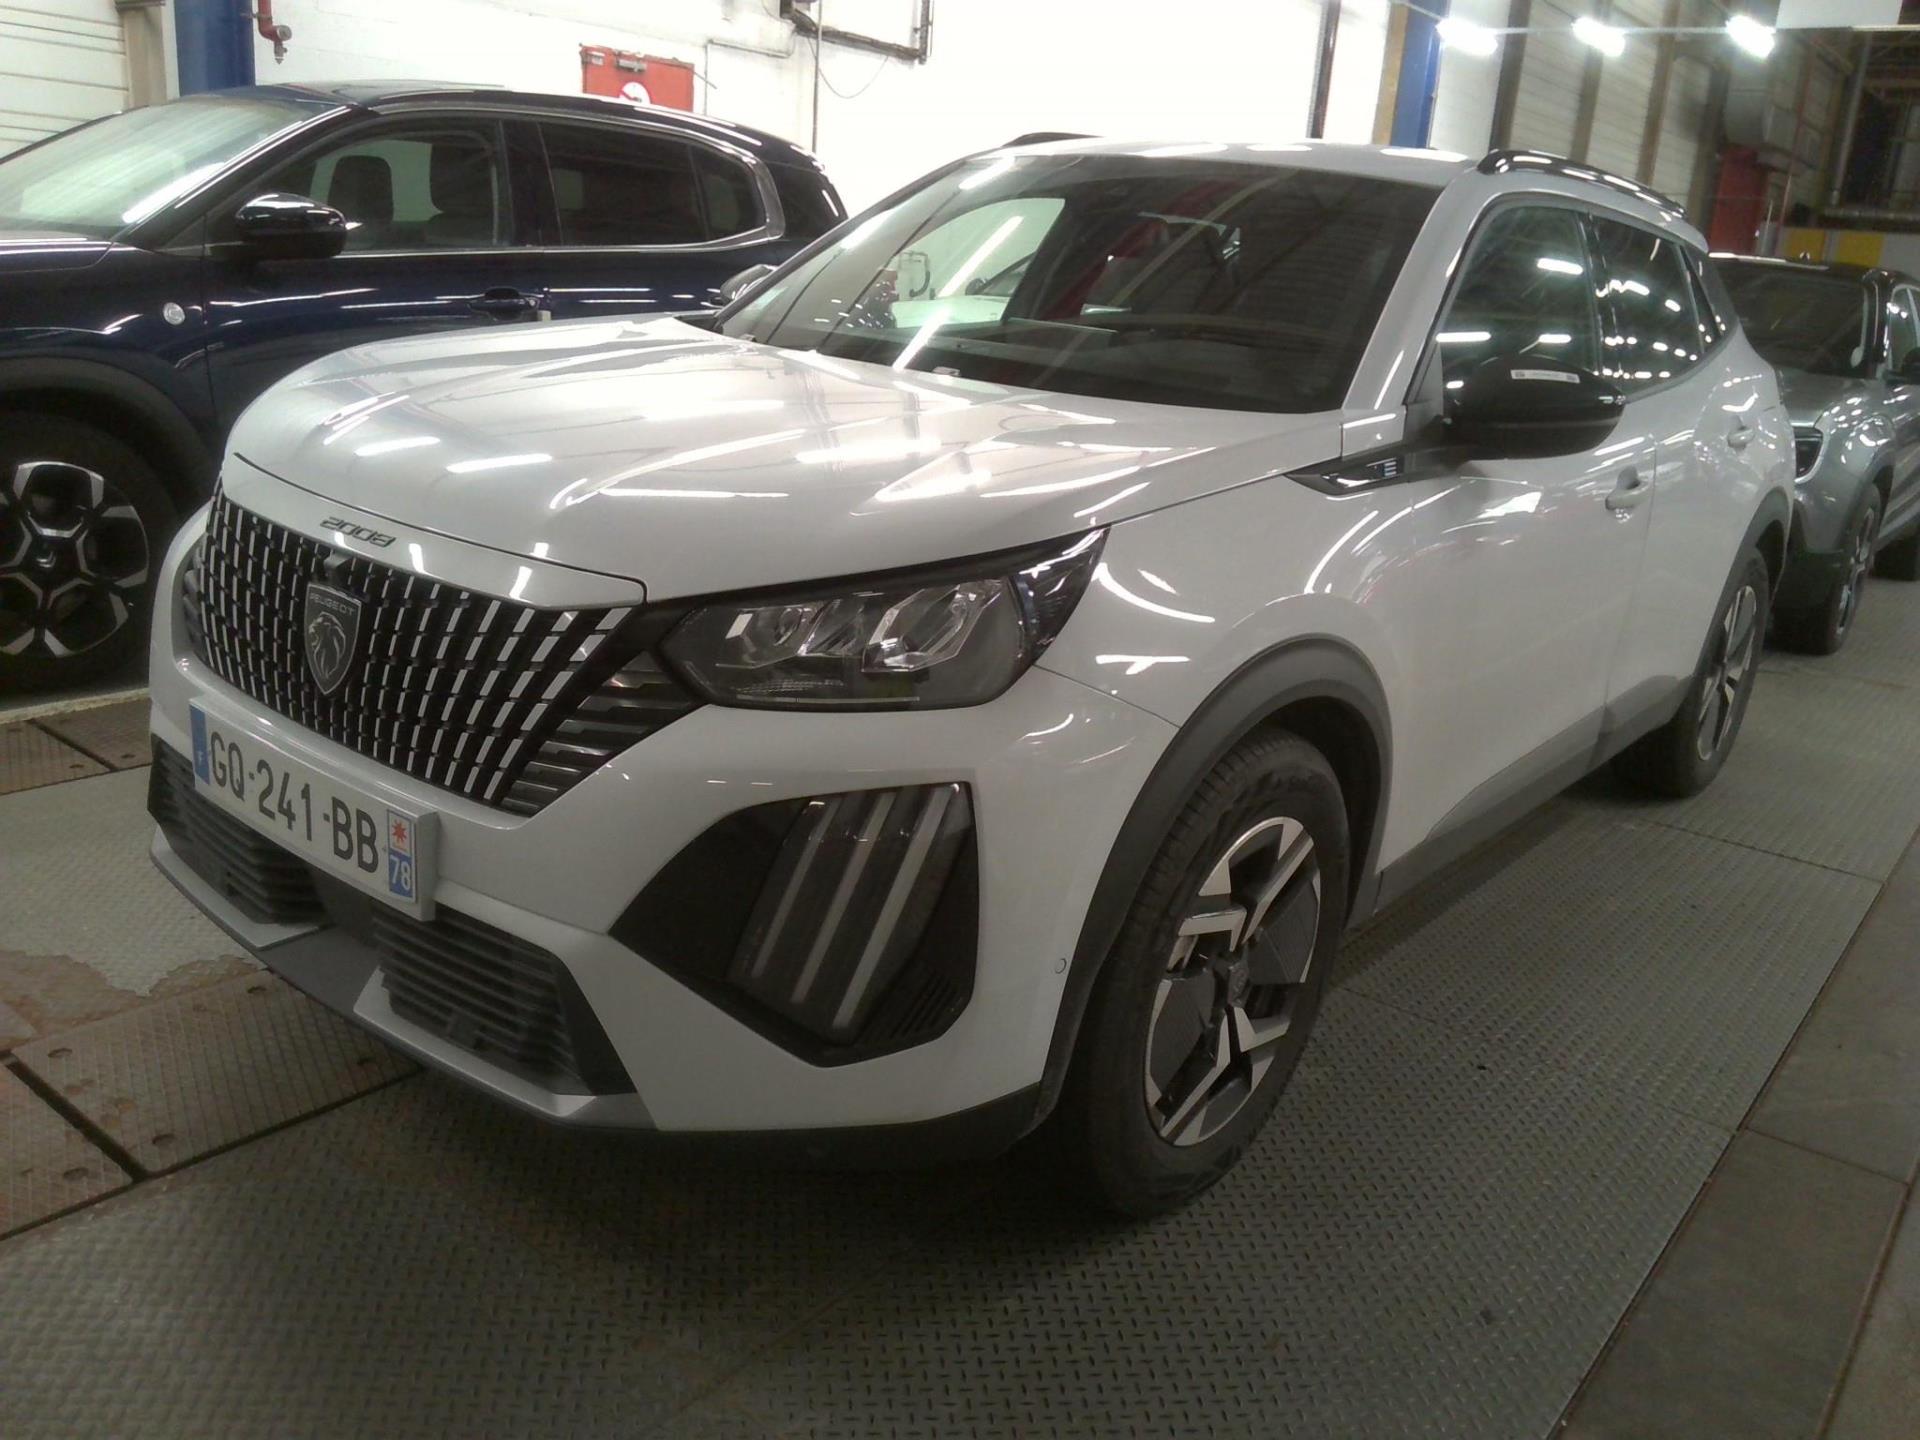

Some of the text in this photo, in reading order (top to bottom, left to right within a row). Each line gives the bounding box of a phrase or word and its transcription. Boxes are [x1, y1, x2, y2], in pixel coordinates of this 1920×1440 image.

[320, 516, 397, 548] 2008
[210, 731, 379, 874] GQ-241-BB
[390, 855, 411, 891] 78
